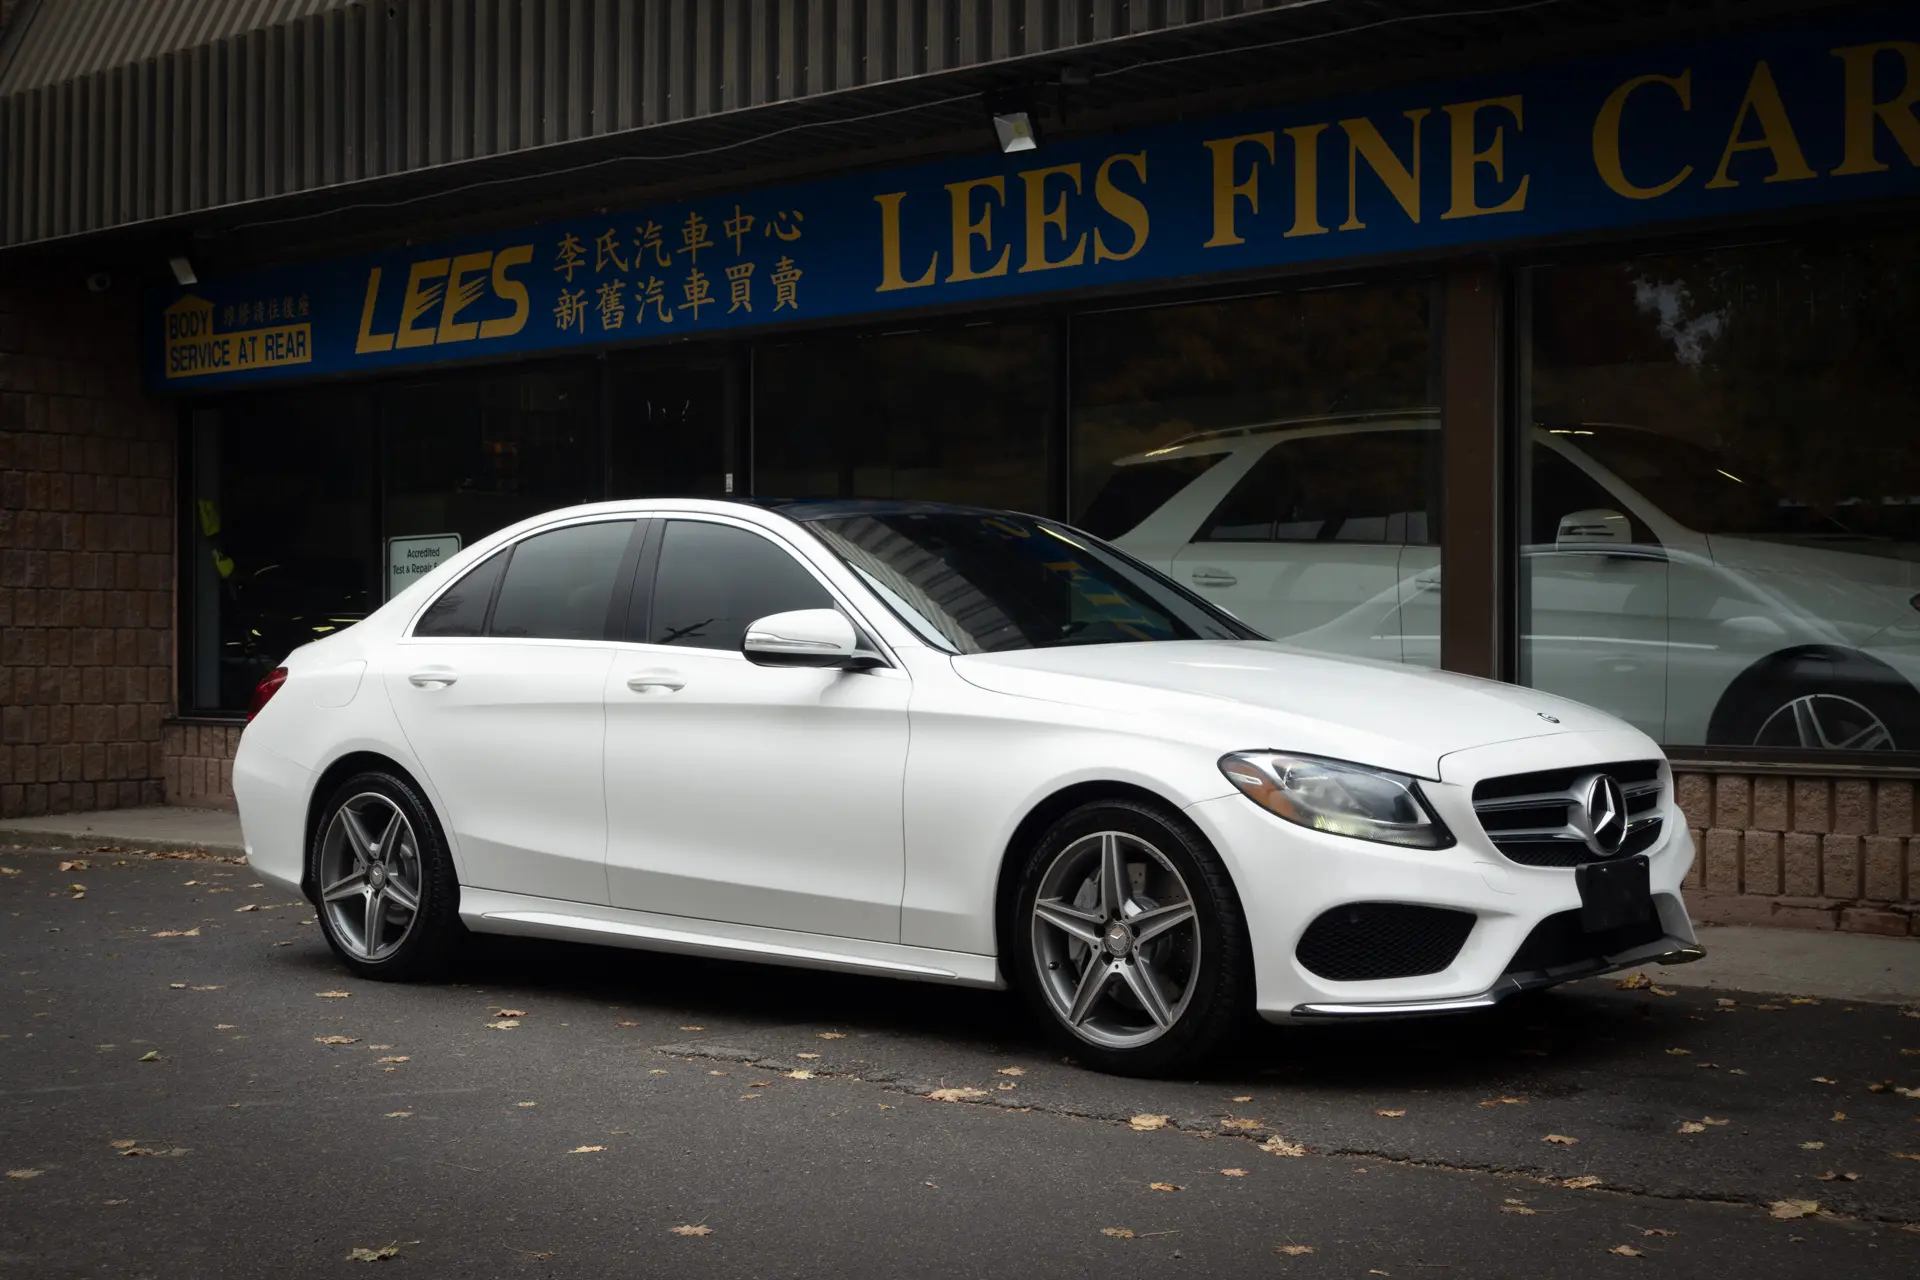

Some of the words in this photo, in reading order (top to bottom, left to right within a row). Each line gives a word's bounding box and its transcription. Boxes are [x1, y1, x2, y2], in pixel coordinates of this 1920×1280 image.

[873, 151, 1150, 293] LEES
[1203, 94, 1530, 248] FINE
[1592, 40, 1920, 199] CAR
[553, 204, 804, 283] 李氏汽車中心
[169, 309, 208, 339] BODY
[355, 244, 535, 355] LEES
[553, 255, 804, 334] 新舊汽車買賣
[170, 340, 231, 372] SERVICE
[238, 336, 258, 364] AT
[265, 330, 306, 361] REAR
[392, 565, 405, 575] Test
[411, 563, 433, 575] Repair
[406, 547, 440, 559] Accredited
